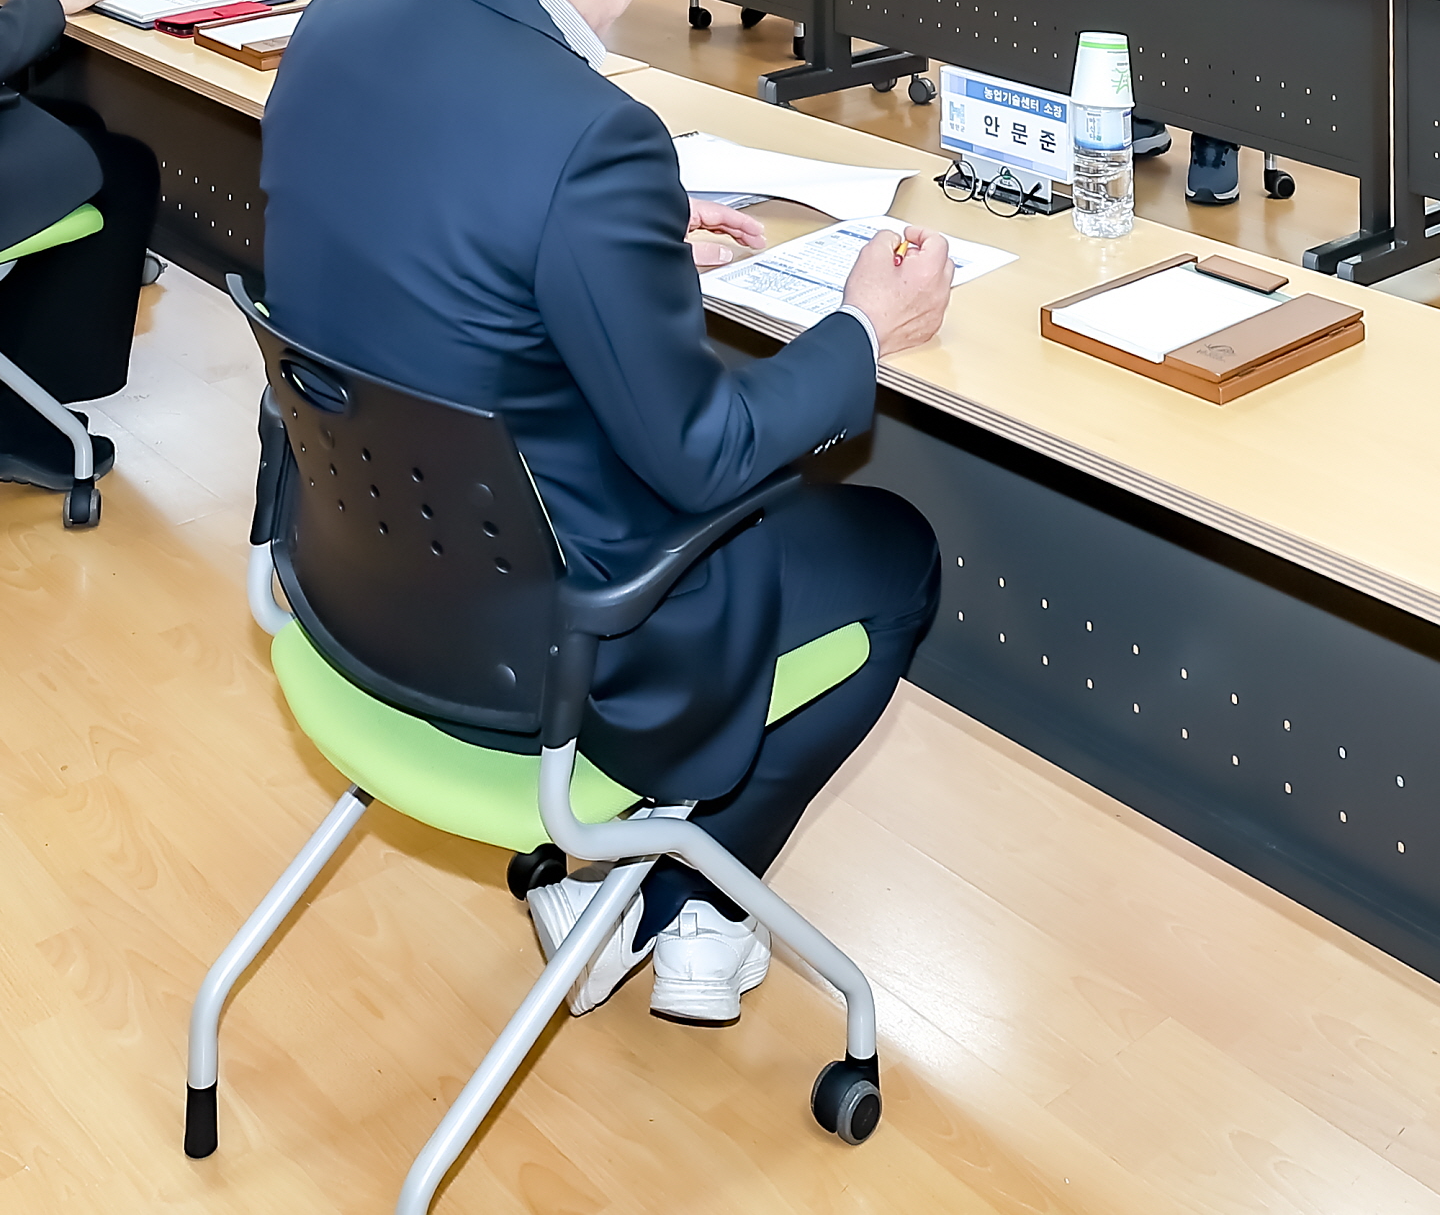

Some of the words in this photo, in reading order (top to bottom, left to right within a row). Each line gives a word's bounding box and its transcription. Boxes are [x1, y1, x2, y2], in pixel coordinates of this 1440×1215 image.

[983, 86, 1040, 112] 농업기술센터
[1043, 102, 1063, 119] 소장
[983, 114, 1057, 155] 안문준
